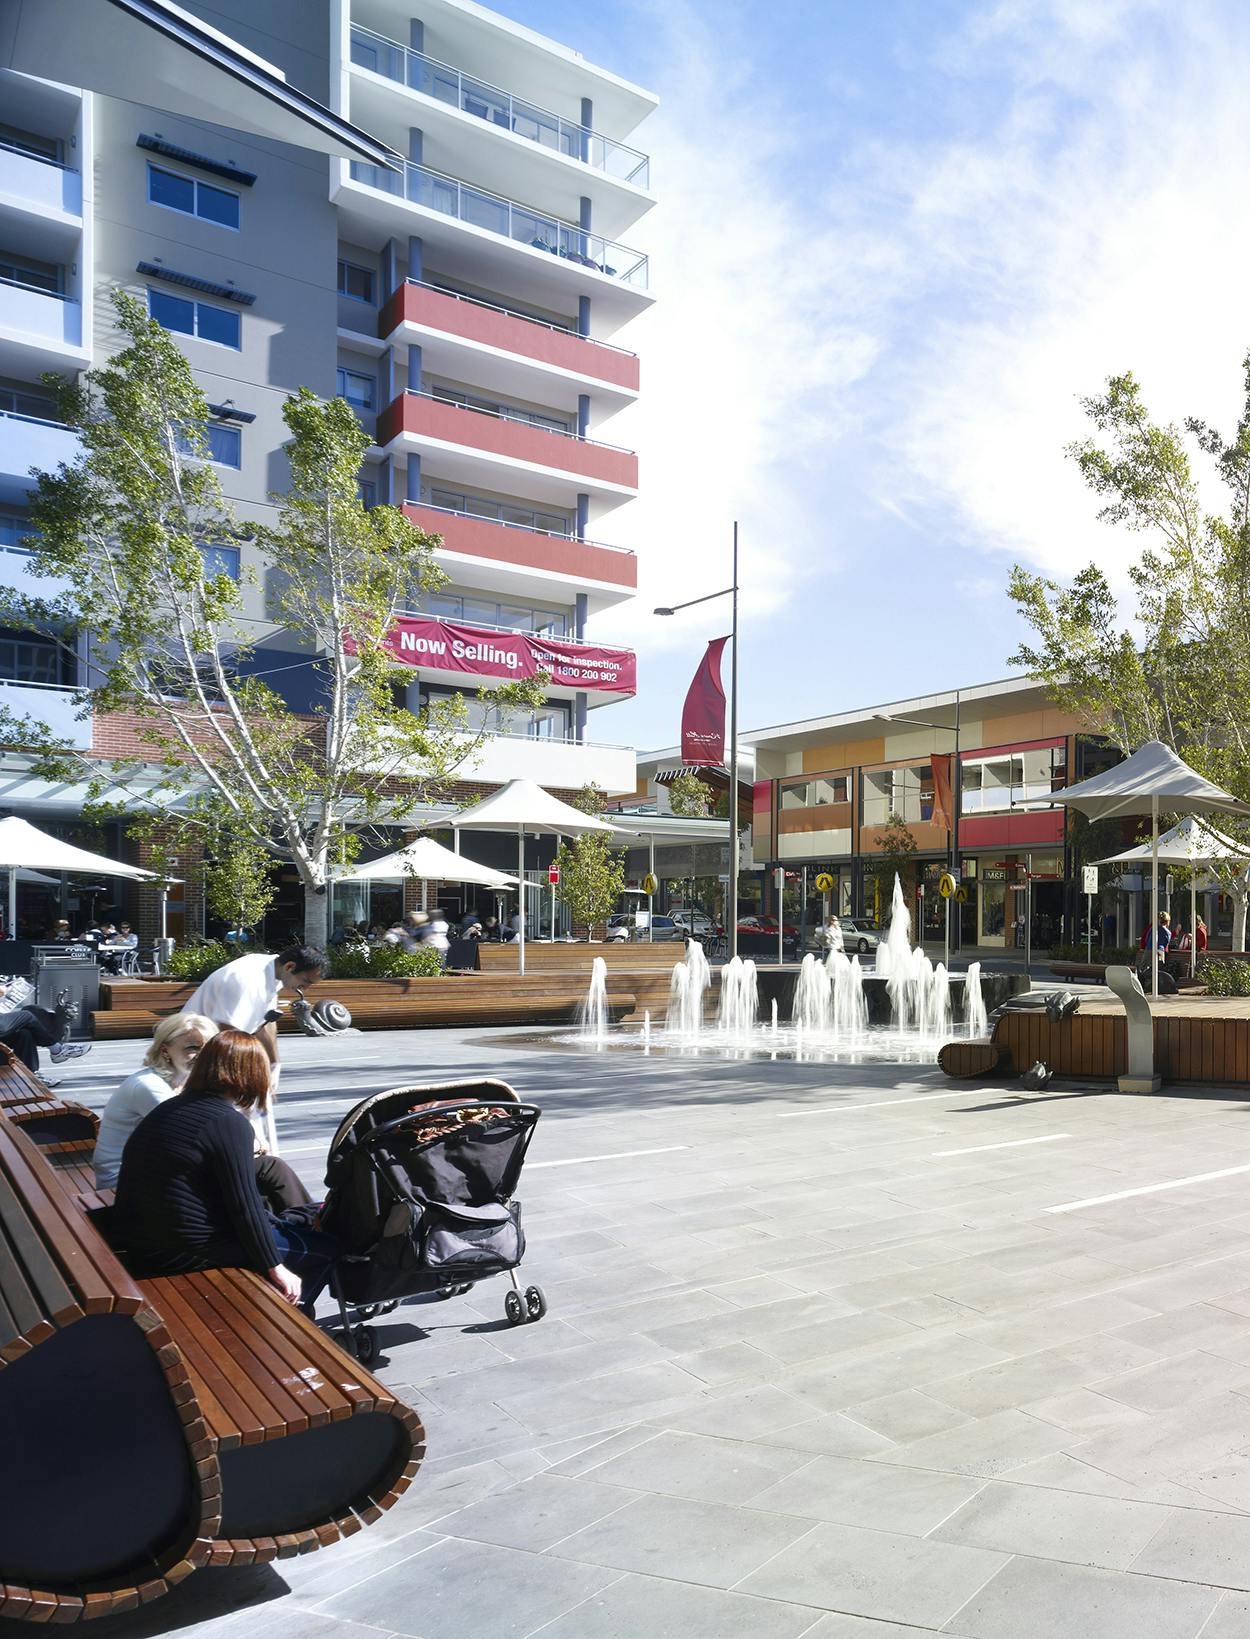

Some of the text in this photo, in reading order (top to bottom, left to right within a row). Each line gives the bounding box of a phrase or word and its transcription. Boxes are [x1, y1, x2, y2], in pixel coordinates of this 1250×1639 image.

[400, 632, 523, 670] Now Selling.
[530, 649, 623, 671] Open for inspection.
[536, 663, 617, 683] Call 1800 200 902
